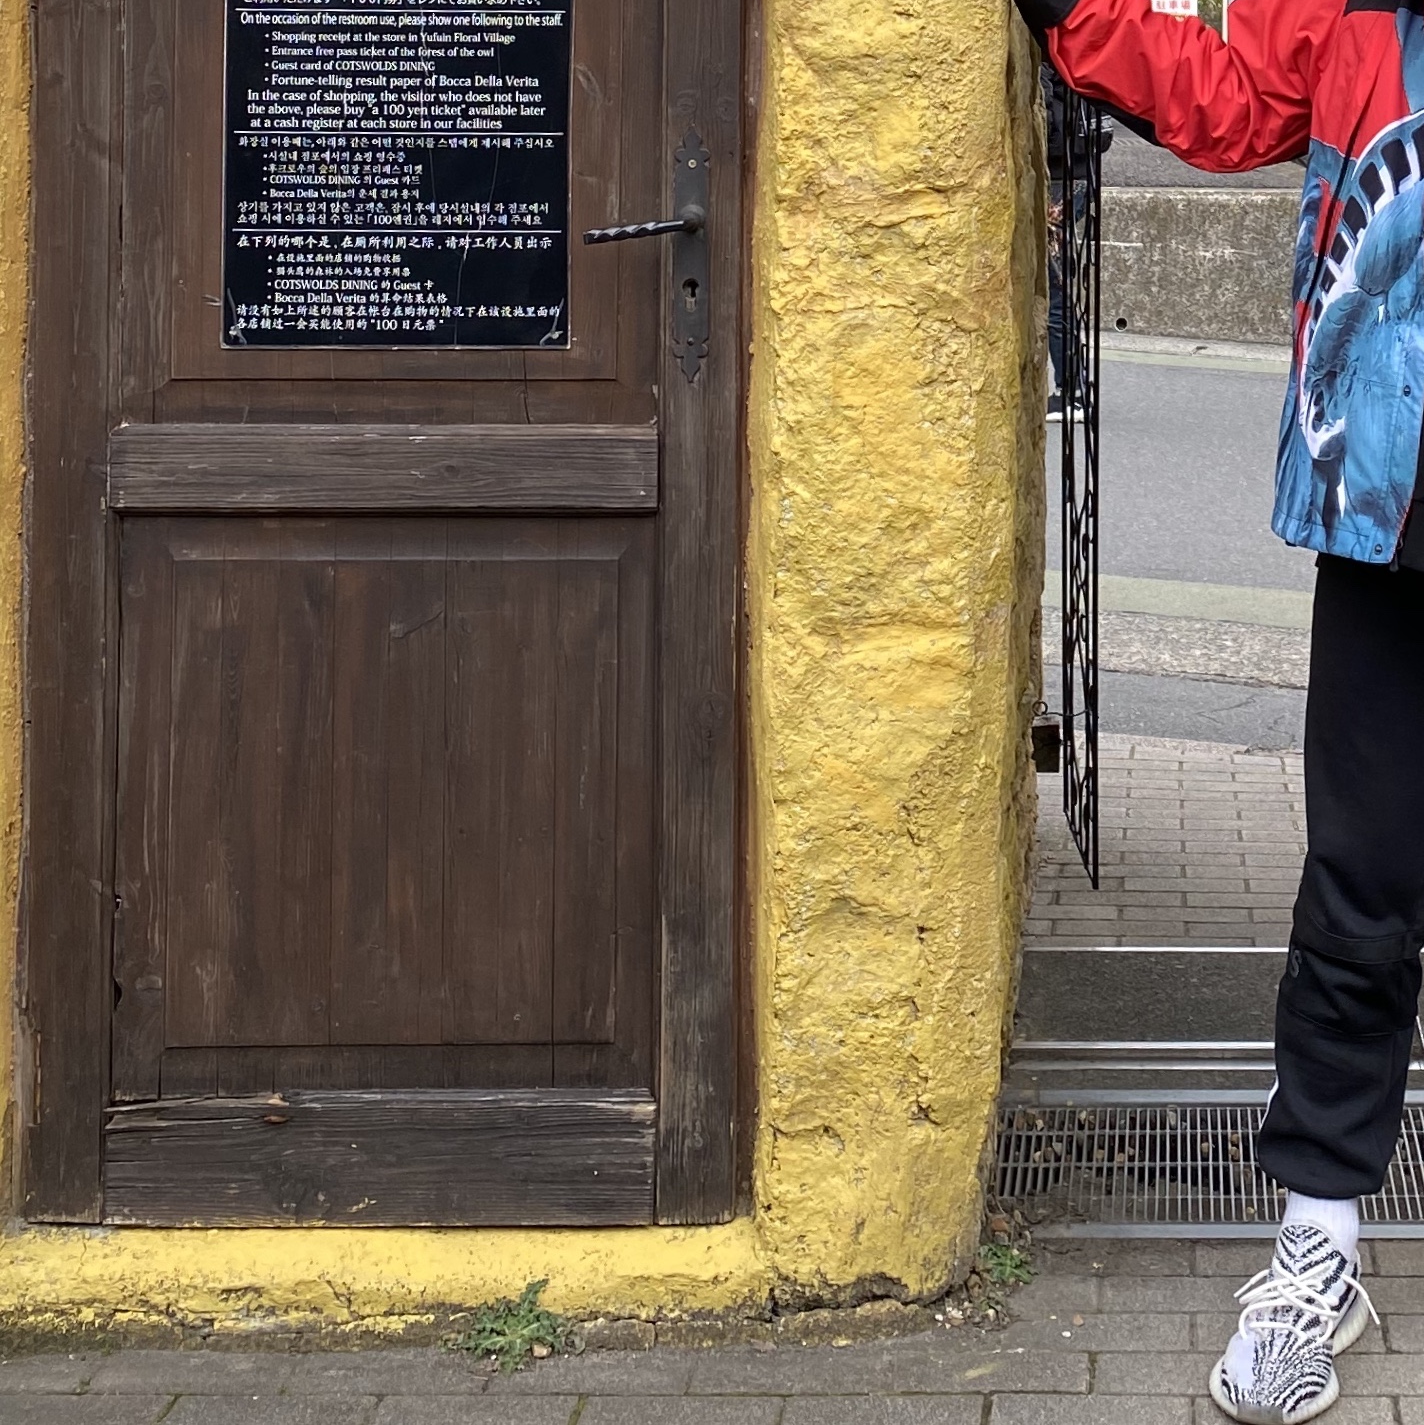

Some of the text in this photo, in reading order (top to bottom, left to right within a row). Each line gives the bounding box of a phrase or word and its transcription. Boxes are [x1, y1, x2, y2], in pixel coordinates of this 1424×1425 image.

[240, 11, 253, 24] On
[255, 11, 270, 24] the
[271, 12, 309, 24] occasion
[311, 11, 321, 24] of
[322, 12, 337, 24] the
[338, 14, 377, 25] restroom
[398, 12, 426, 27] please
[428, 12, 451, 25] show
[452, 16, 470, 26] one
[471, 12, 512, 28] following
[514, 15, 524, 26] to
[525, 13, 540, 26] the
[272, 30, 515, 45] Shopping receipt at the store in Yufuin Floral Village
[272, 45, 493, 57] Entrance free pass ticket of the forest of the owl
[271, 60, 435, 71] Guest card of COTSWOLDS DINING
[271, 73, 539, 89] Fortune-telling result paper of Bocca Della Verita
[247, 88, 259, 101] In
[262, 89, 280, 101] the
[282, 92, 307, 100] case
[309, 89, 322, 101] of
[380, 89, 398, 101] the
[401, 89, 436, 102] visitor
[438, 90, 462, 102] who
[465, 90, 491, 102] does
[491, 92, 512, 102] not
[515, 90, 541, 102] have
[247, 104, 265, 113] the
[306, 104, 341, 117] please
[343, 104, 365, 117] buy
[383, 104, 404, 115] 100
[406, 104, 427, 118] yen
[468, 104, 517, 116] available
[520, 104, 546, 115] later
[250, 116, 502, 131] at a cash register at each store in our facilities
[269, 174, 326, 184] COTSWOLDS
[328, 174, 360, 184] DINING
[374, 175, 398, 185] Guest
[269, 188, 294, 197] Bocca
[296, 188, 318, 197] Della
[274, 279, 339, 289] COTSWOLDS
[341, 279, 377, 290] DINING
[393, 279, 420, 290] Guest
[274, 291, 366, 303] Bocca Della Verita
